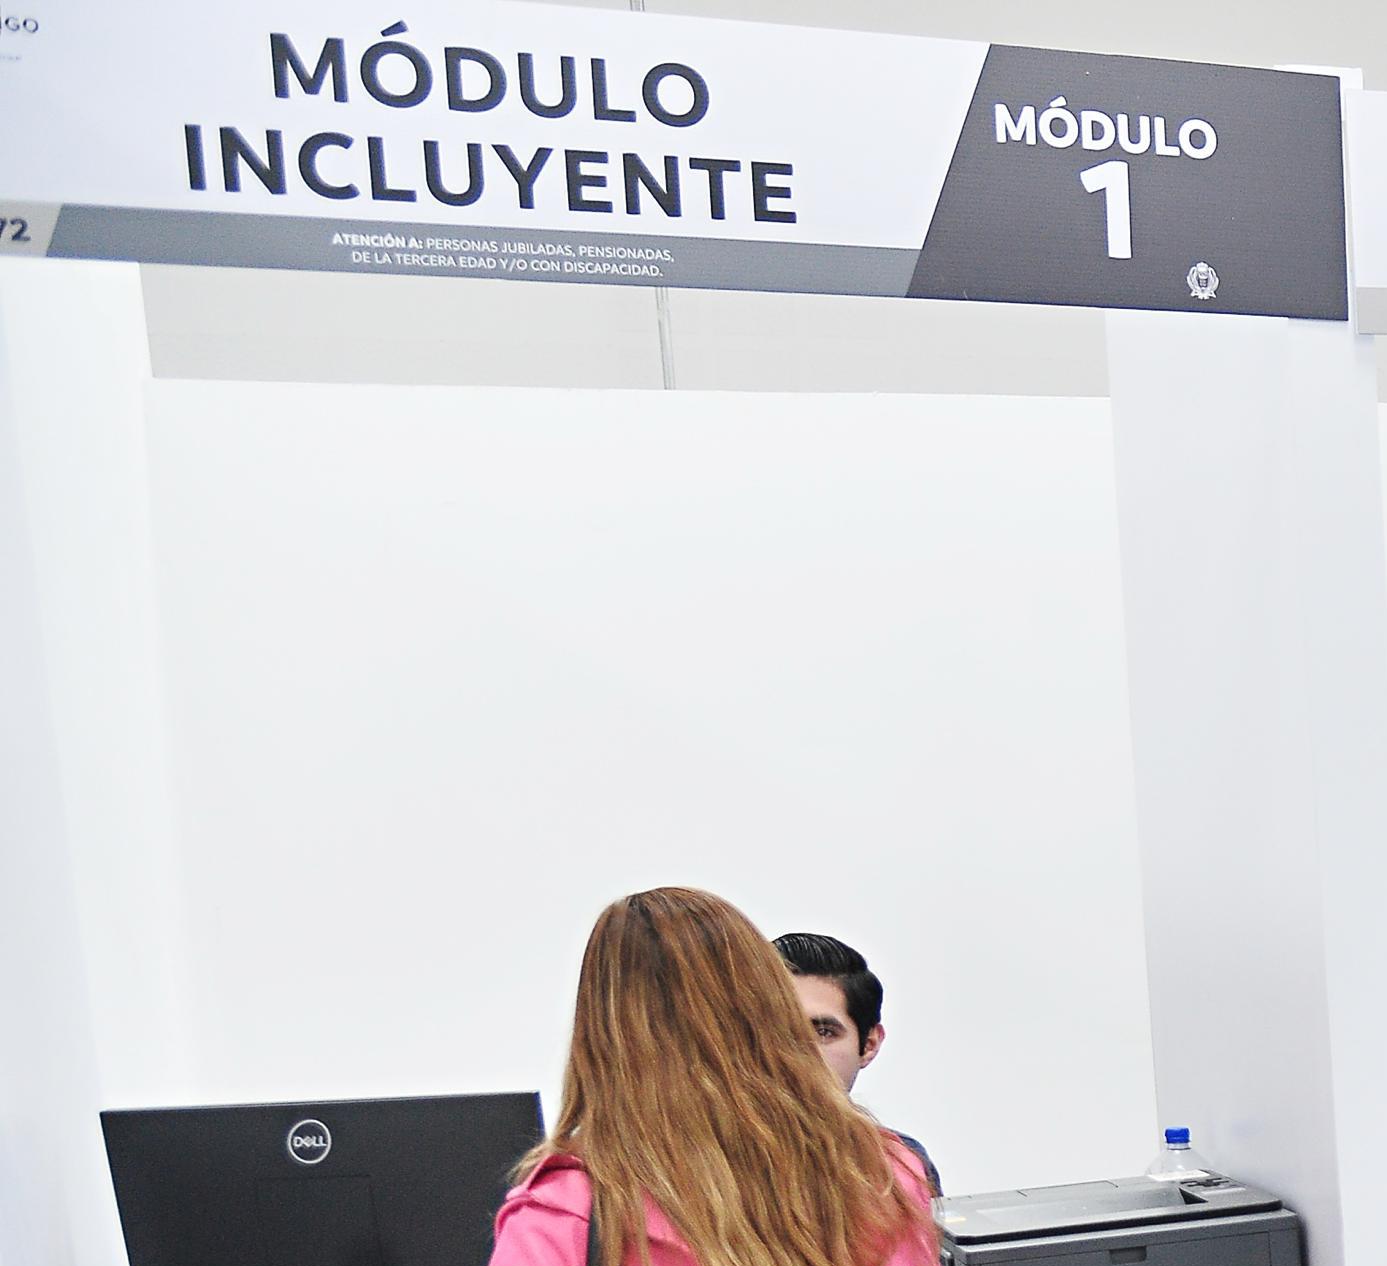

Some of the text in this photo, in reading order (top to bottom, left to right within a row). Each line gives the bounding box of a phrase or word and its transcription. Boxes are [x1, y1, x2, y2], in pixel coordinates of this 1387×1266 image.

[269, 20, 710, 128] MÓDULO
[994, 96, 1217, 160] MÓDULO
[184, 123, 797, 223] INCLUYENTE
[1079, 160, 1132, 259] 1
[332, 231, 674, 261] ATENCIÓN A: PERSONAS JUBILADAS, PENSIONADAS,
[352, 251, 370, 263] DE
[374, 252, 391, 264] LA
[395, 253, 456, 266] TERCERA
[459, 256, 496, 268] EDAD
[531, 259, 560, 271] CON
[563, 261, 663, 276] DISCAPACIDAD.
[293, 1135, 328, 1148] DELL
